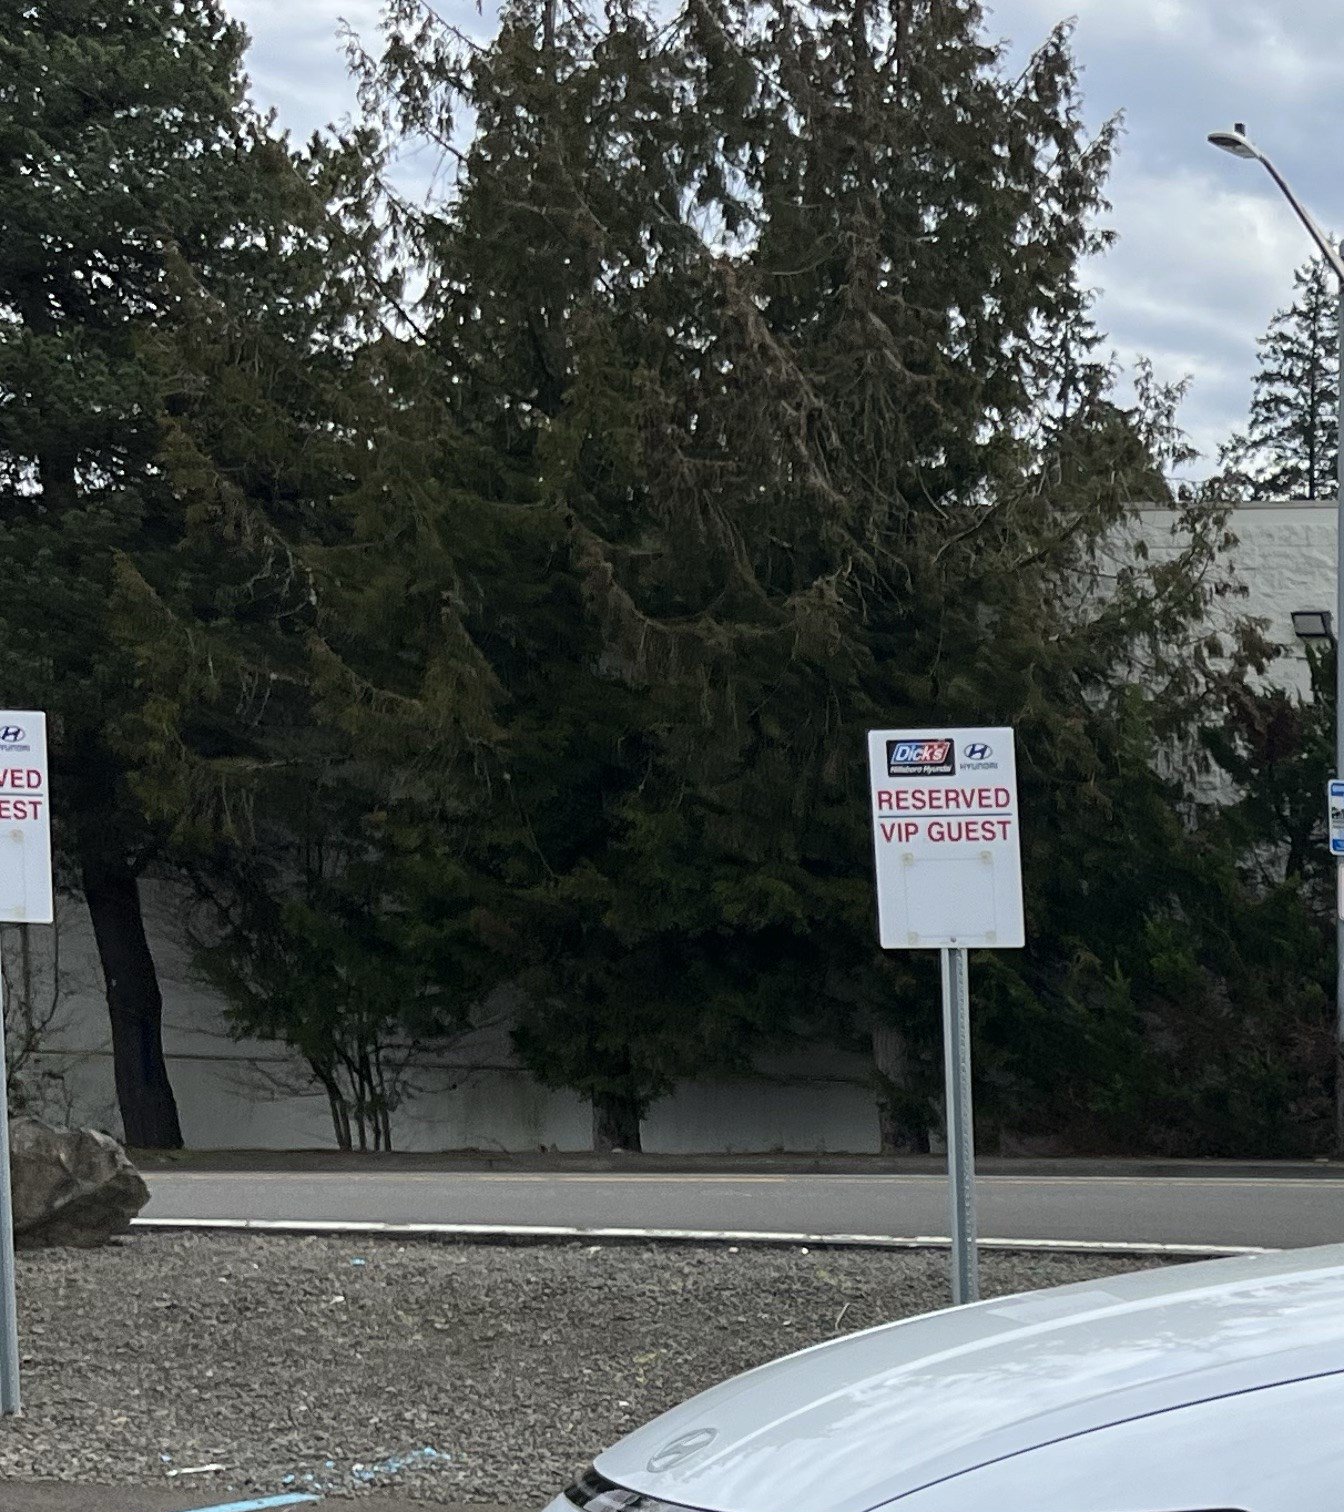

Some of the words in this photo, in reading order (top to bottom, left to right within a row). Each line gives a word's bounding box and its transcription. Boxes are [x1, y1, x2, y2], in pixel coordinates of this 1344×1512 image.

[895, 744, 943, 761] Dick's
[877, 787, 1011, 811] RESERVED
[880, 822, 919, 843] VIP
[927, 820, 1012, 843] GUEST
